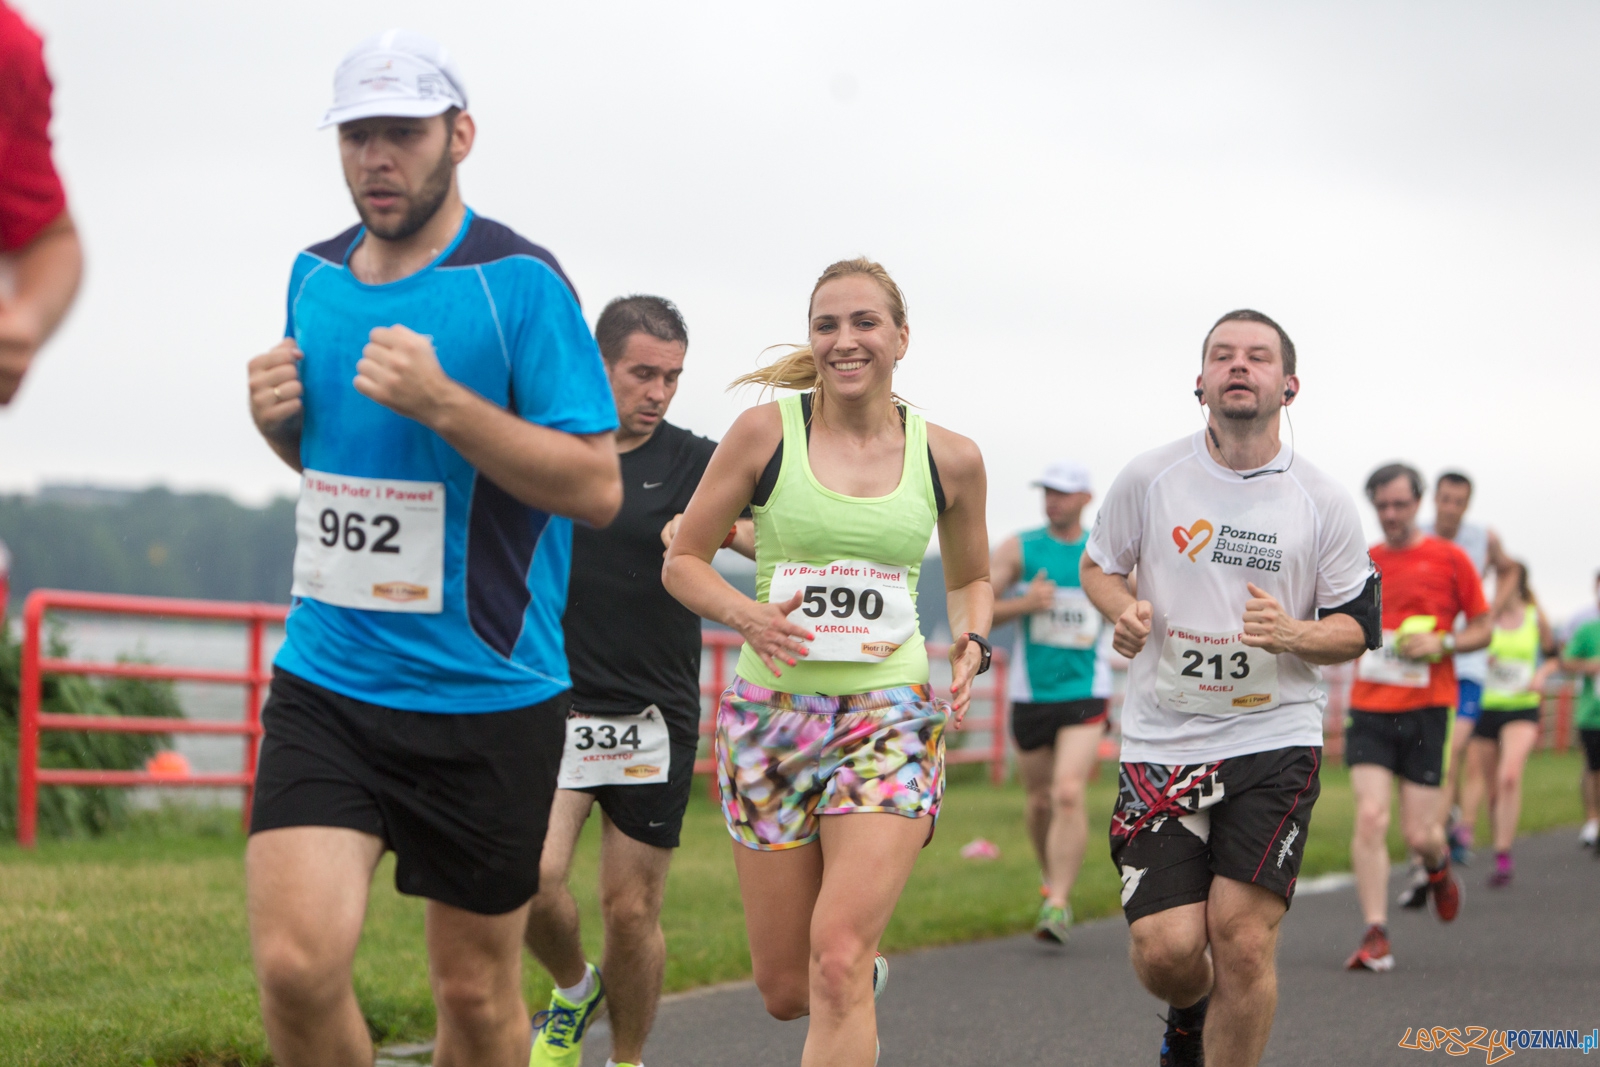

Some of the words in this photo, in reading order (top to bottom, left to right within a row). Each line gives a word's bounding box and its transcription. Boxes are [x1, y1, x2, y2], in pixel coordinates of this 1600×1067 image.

[316, 479, 338, 497] Bieg
[341, 483, 371, 498] Piotr
[376, 486, 381, 498] i
[385, 487, 434, 502] Paweł
[319, 508, 401, 554] 962
[1219, 525, 1278, 544] Poznań
[1215, 538, 1283, 559] Business
[1211, 551, 1243, 566] Run
[1246, 556, 1281, 572] 2015
[783, 568, 797, 577] IV
[831, 565, 860, 577] Piotr
[863, 568, 867, 577] i
[870, 568, 901, 582] Paweł
[802, 585, 884, 620] 590
[815, 625, 870, 635] KAROLINA
[1178, 631, 1201, 643] Bieg
[1203, 636, 1230, 645] Piotr
[1232, 635, 1235, 643] i
[1181, 649, 1250, 680] 213
[1199, 684, 1234, 692] MACIEJ
[574, 724, 641, 750] 334
[583, 753, 634, 762] KRZYSZTOF
